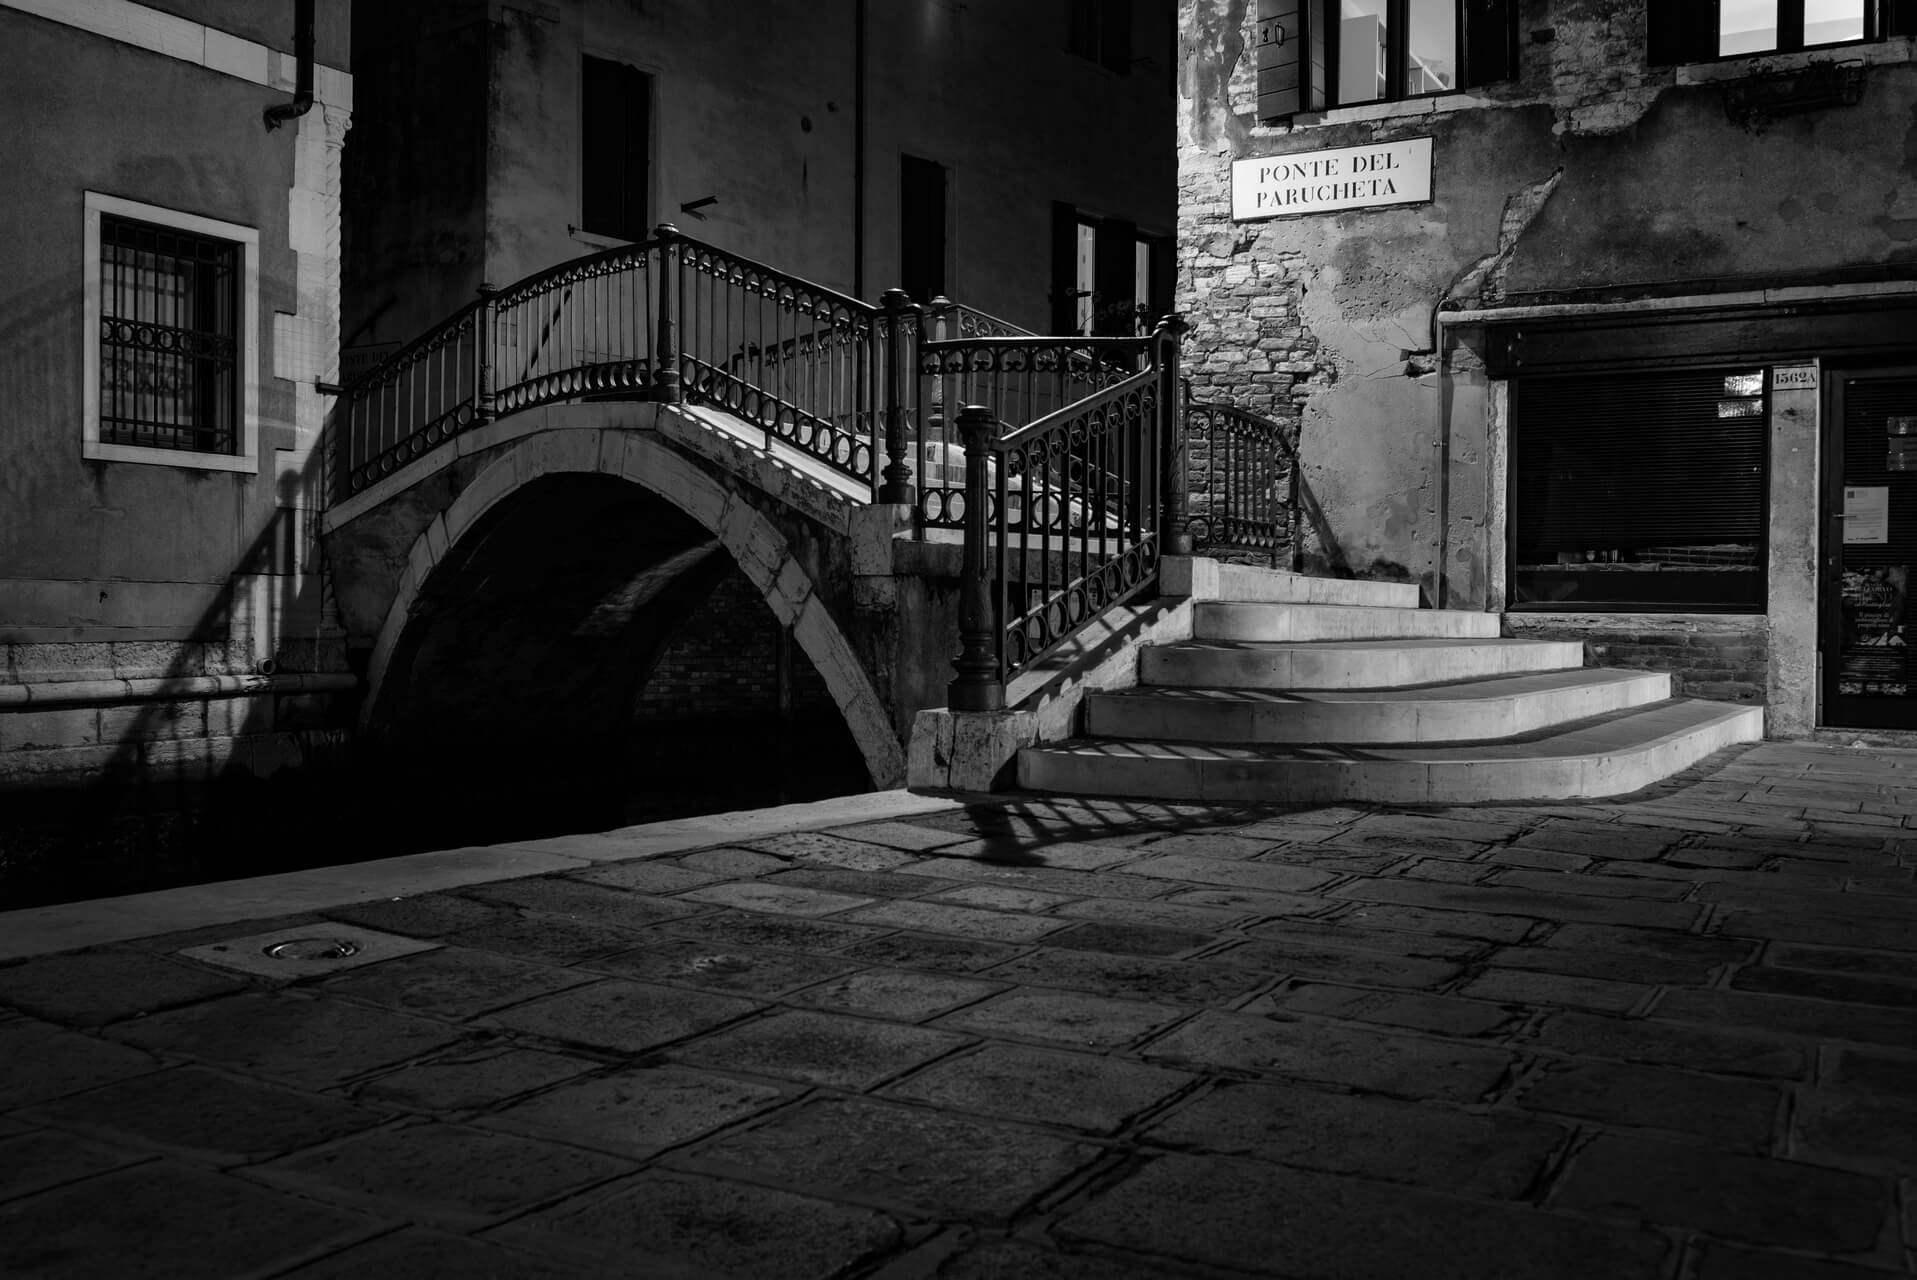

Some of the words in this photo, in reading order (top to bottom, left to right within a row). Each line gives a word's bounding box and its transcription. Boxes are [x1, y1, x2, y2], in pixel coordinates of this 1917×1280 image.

[1260, 158, 1339, 184] PONTE
[1353, 152, 1400, 173] DEL
[1256, 178, 1398, 208] PARUCHETA
[1775, 371, 1816, 384] 1562A
